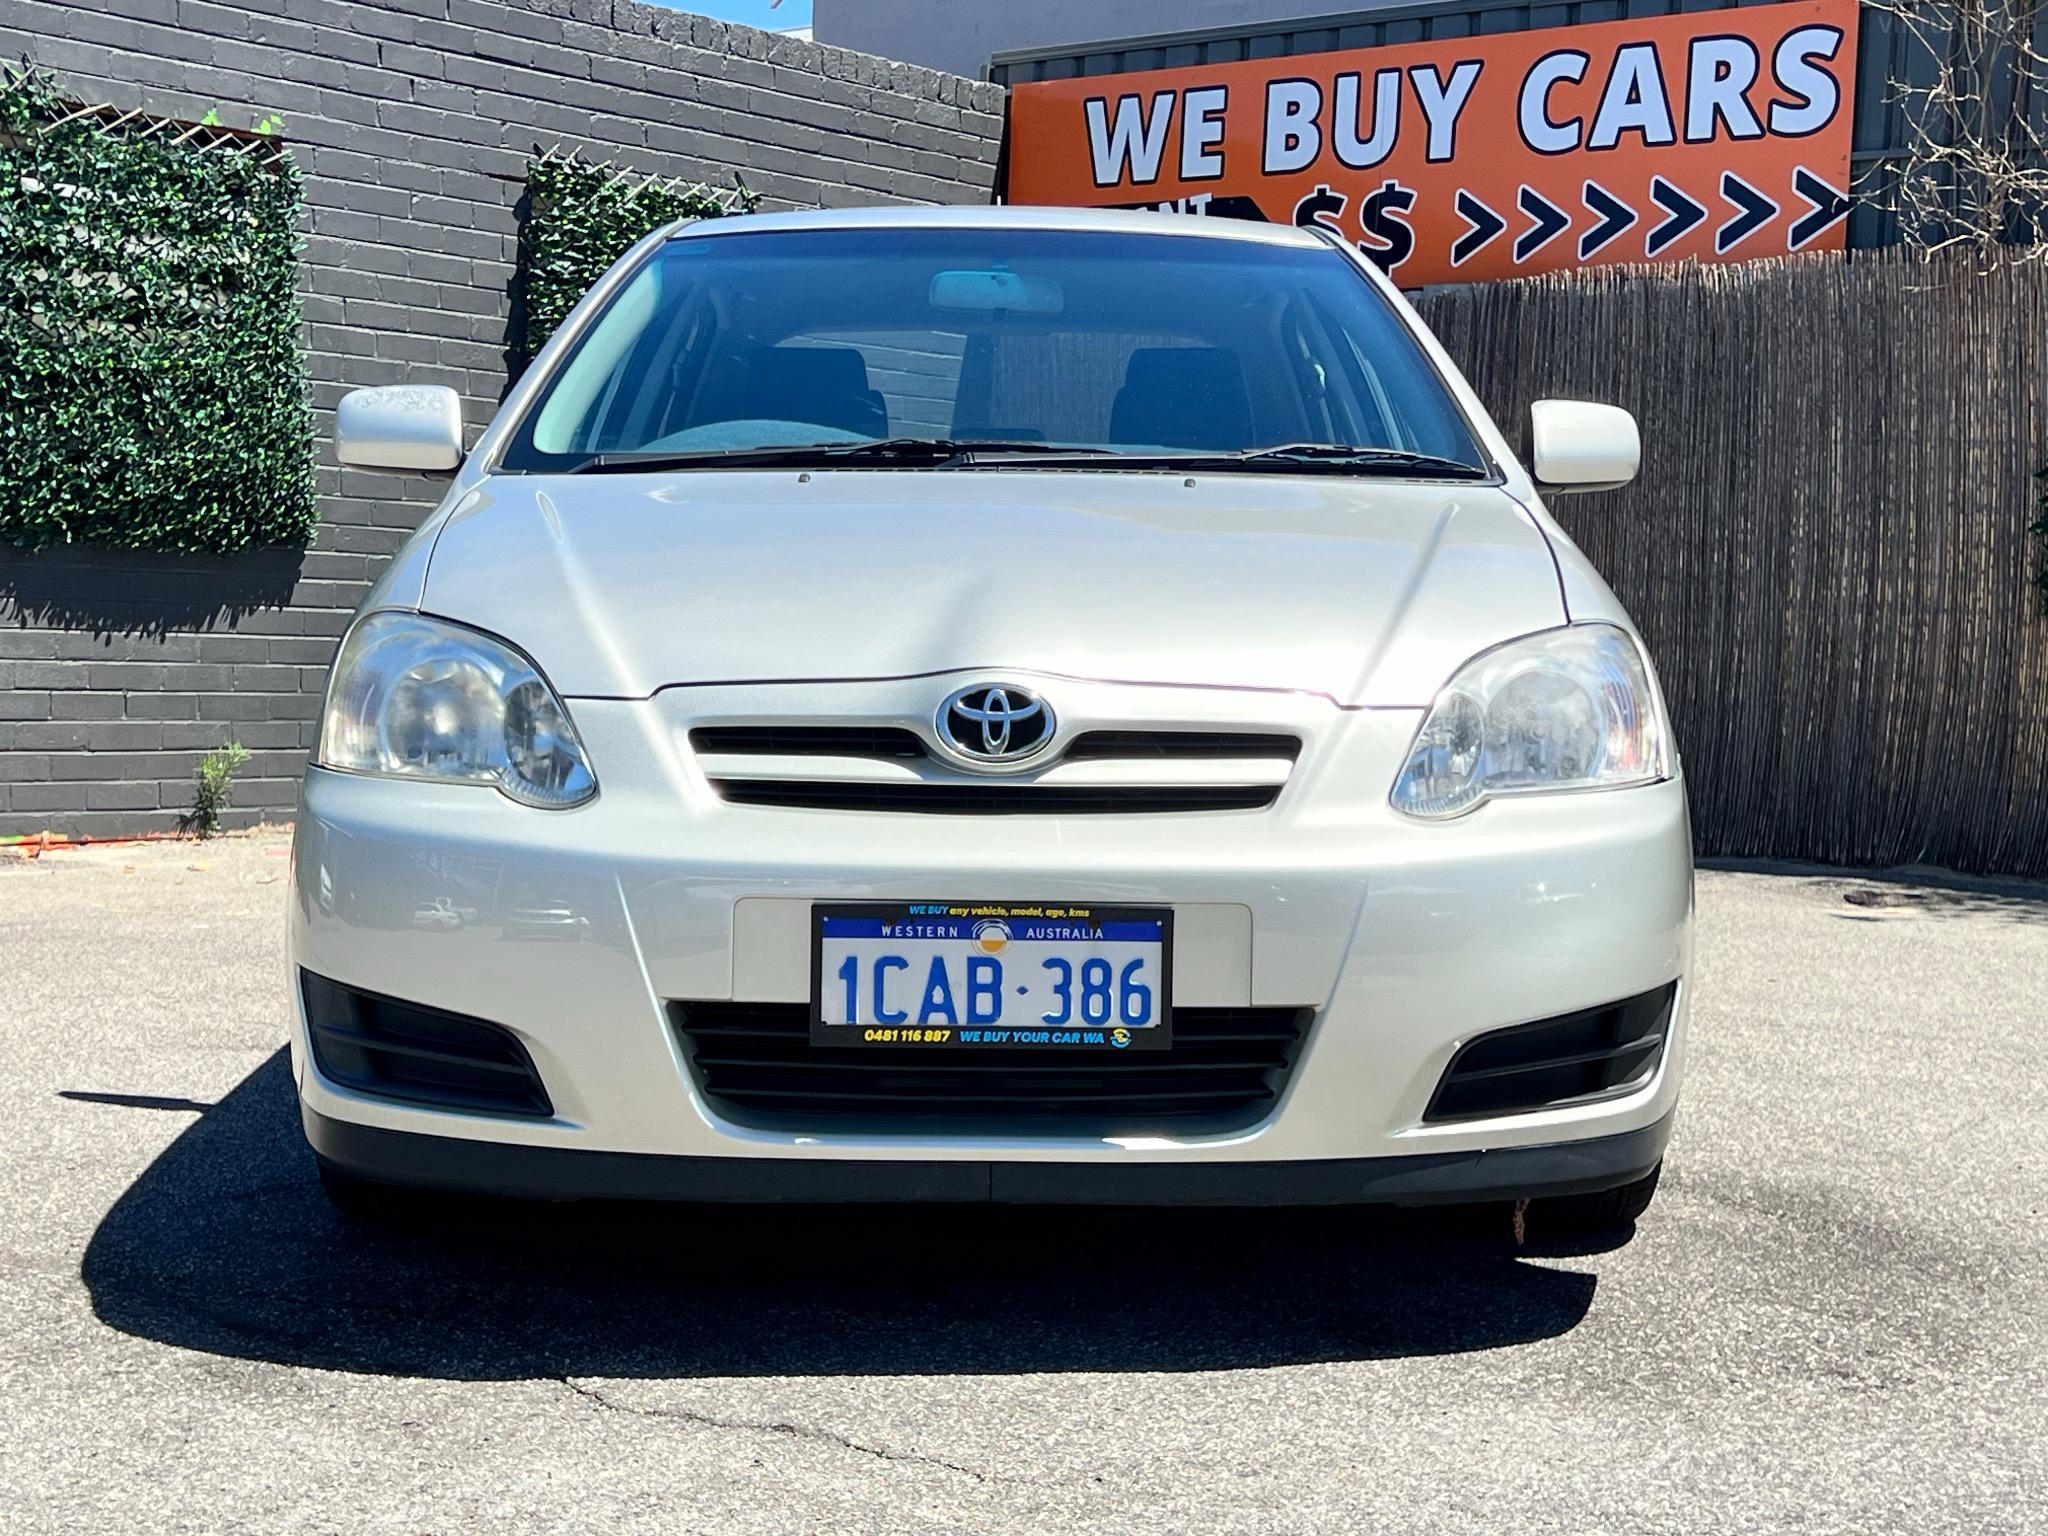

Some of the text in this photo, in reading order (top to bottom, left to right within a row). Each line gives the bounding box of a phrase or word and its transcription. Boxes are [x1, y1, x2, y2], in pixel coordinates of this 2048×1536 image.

[1085, 24, 1845, 187] WE BUY CARS
[909, 905, 1090, 919] WE BUY any vehicle, model, age, kms
[881, 925, 1104, 940] WESTERN AUSTRALIA
[864, 1029, 1105, 1044] 0481 116 887 WE BUY YOUR CAR WA
